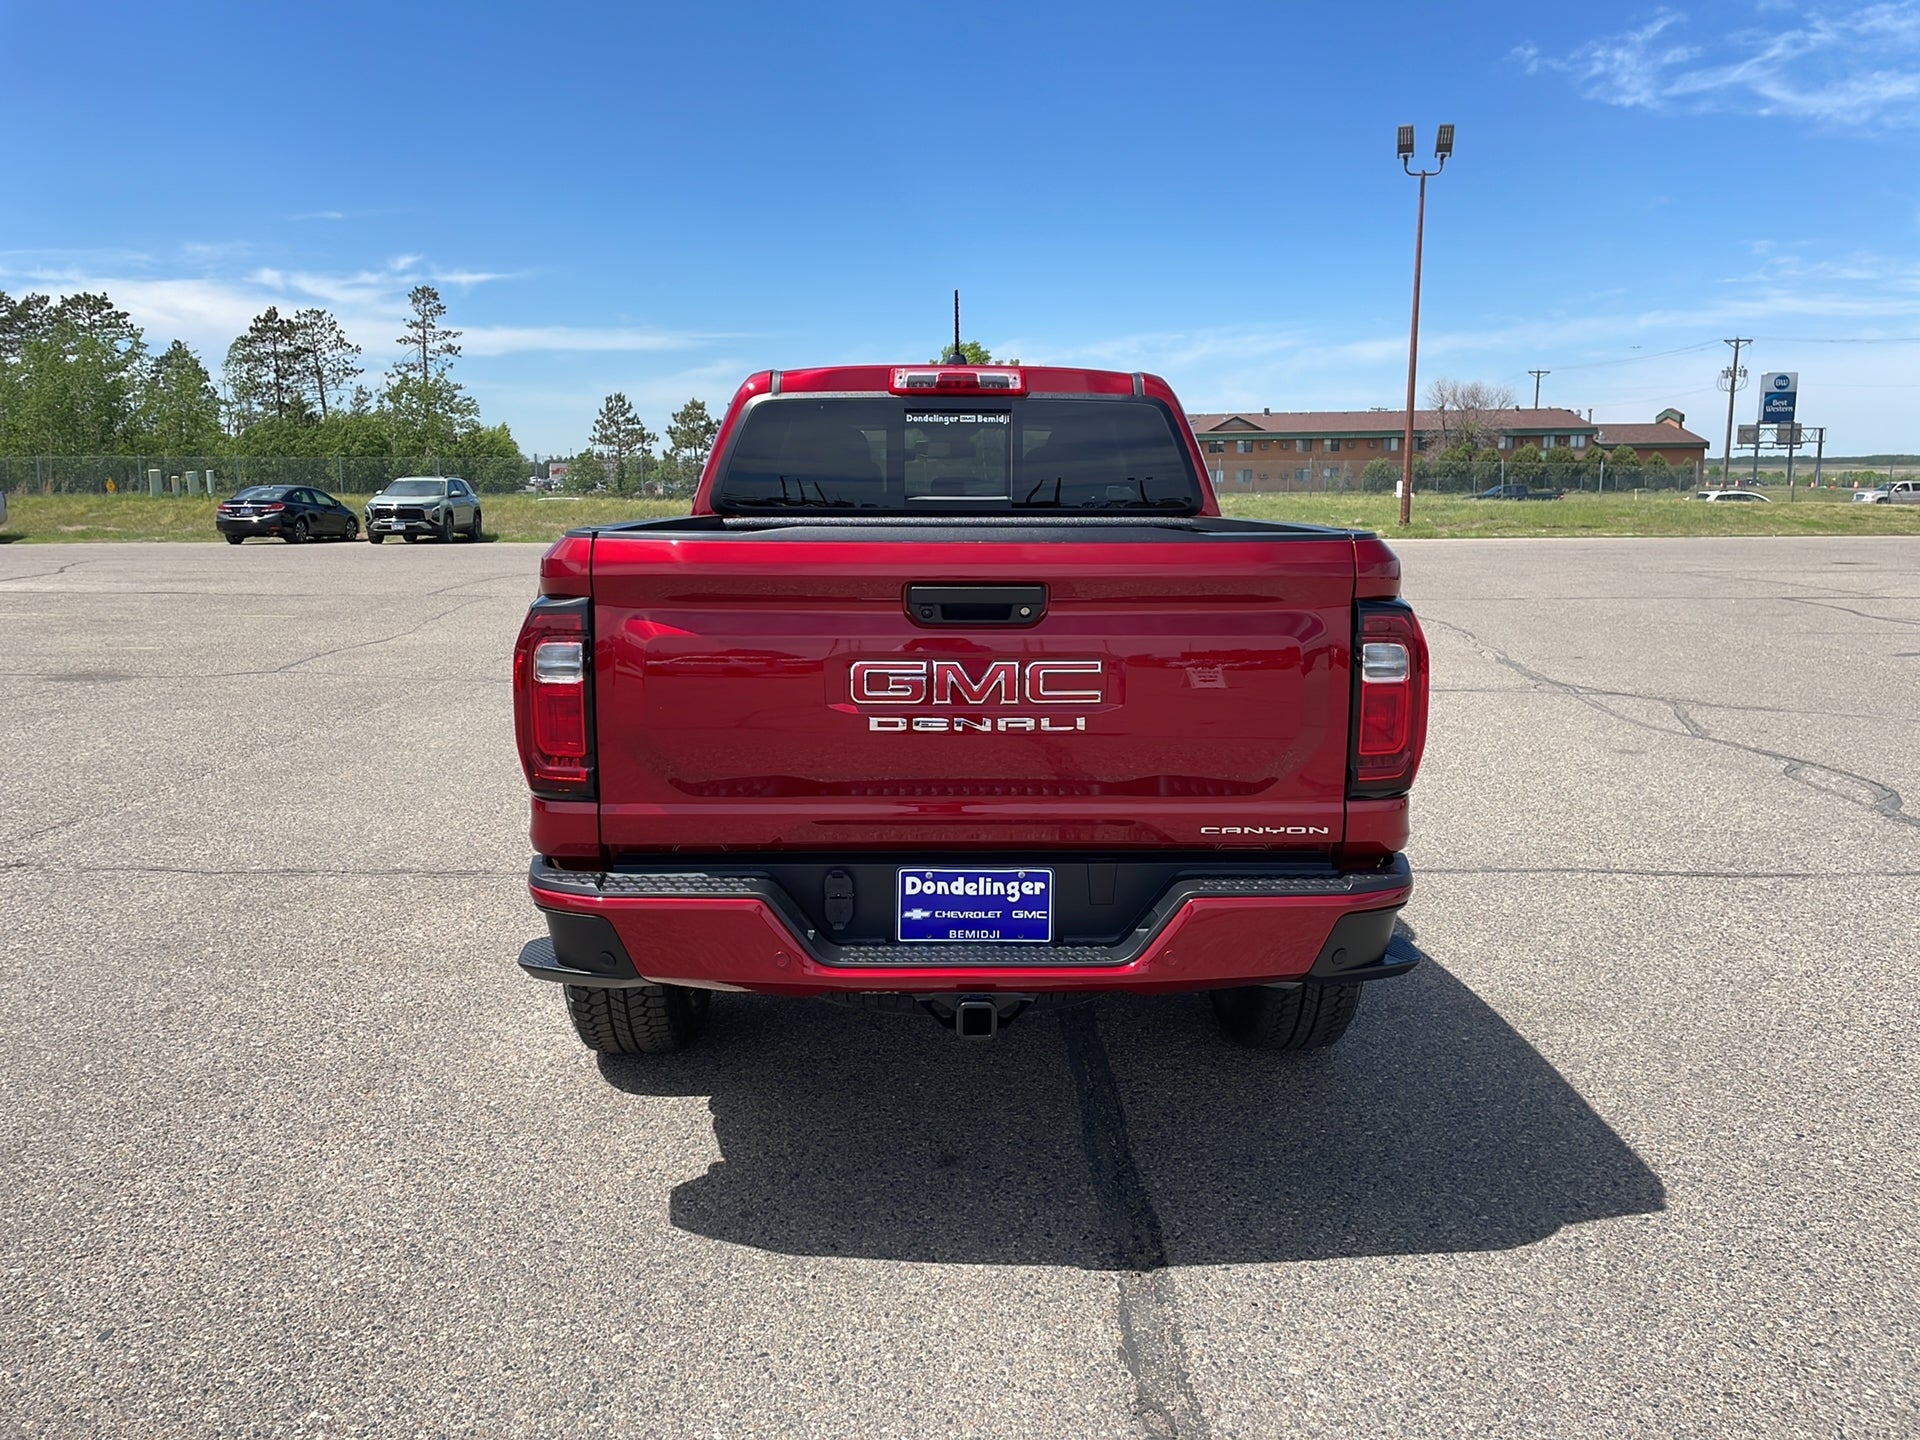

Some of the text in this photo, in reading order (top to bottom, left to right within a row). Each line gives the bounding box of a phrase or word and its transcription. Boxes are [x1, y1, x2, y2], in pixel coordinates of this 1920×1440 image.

[906, 414, 959, 425] Dondelinger
[977, 414, 1010, 425] Bemidji
[850, 660, 1102, 705] GMC
[868, 716, 1086, 732] DENALI
[1200, 826, 1329, 835] CANYON
[905, 876, 1046, 903] Dondelinger
[934, 910, 1048, 919] CHEVROLET GMC
[949, 930, 1000, 939] BEMIDJI
